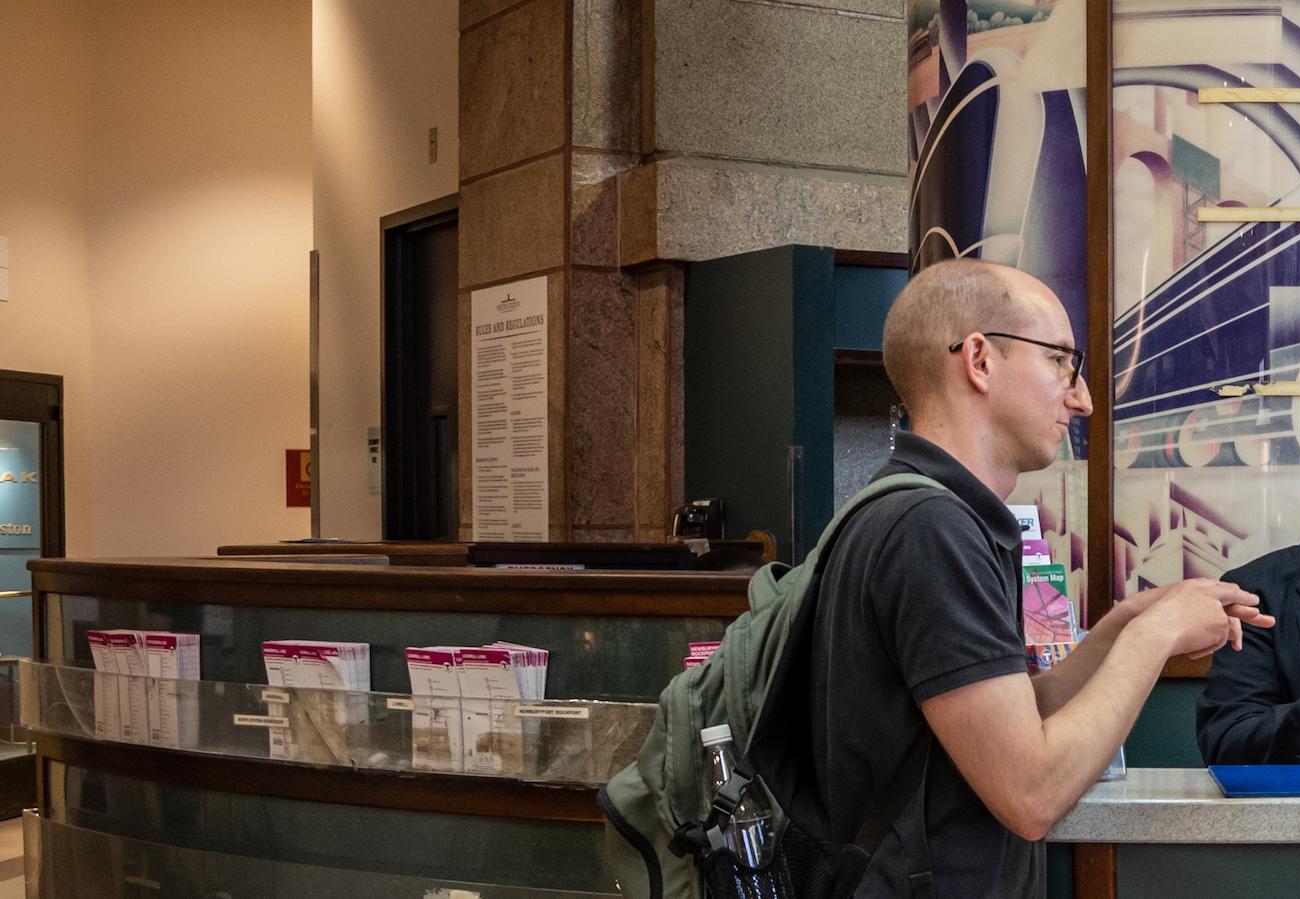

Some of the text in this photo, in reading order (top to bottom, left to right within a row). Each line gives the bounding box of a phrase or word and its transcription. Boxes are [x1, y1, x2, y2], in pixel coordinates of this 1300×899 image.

[475, 314, 545, 336] RULES AND REGULATIONS
[1026, 574, 1064, 584] System Map
